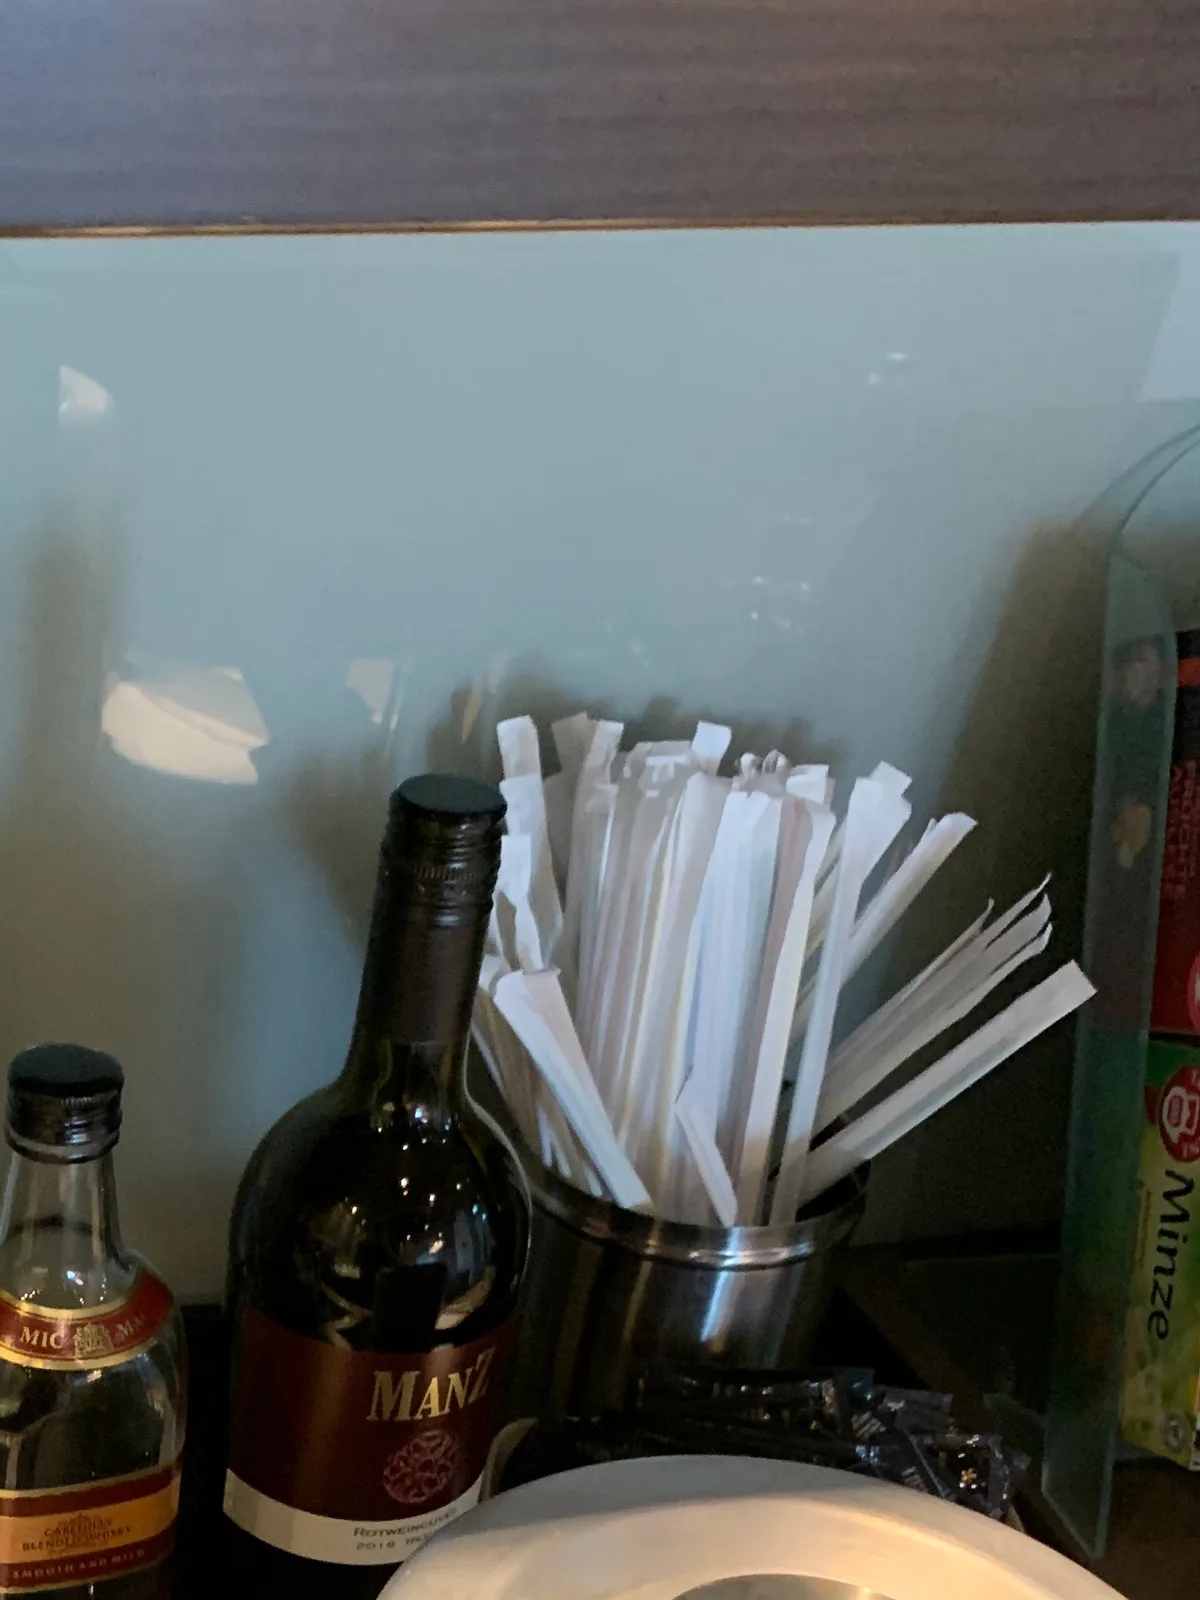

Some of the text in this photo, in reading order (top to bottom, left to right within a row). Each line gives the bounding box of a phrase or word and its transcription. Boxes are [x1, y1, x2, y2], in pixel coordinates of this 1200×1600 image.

[1147, 1169, 1195, 1340] Minze
[19, 1326, 65, 1349] MIC
[366, 1347, 497, 1421] MANZ
[13, 1564, 74, 1580] SMOOTH
